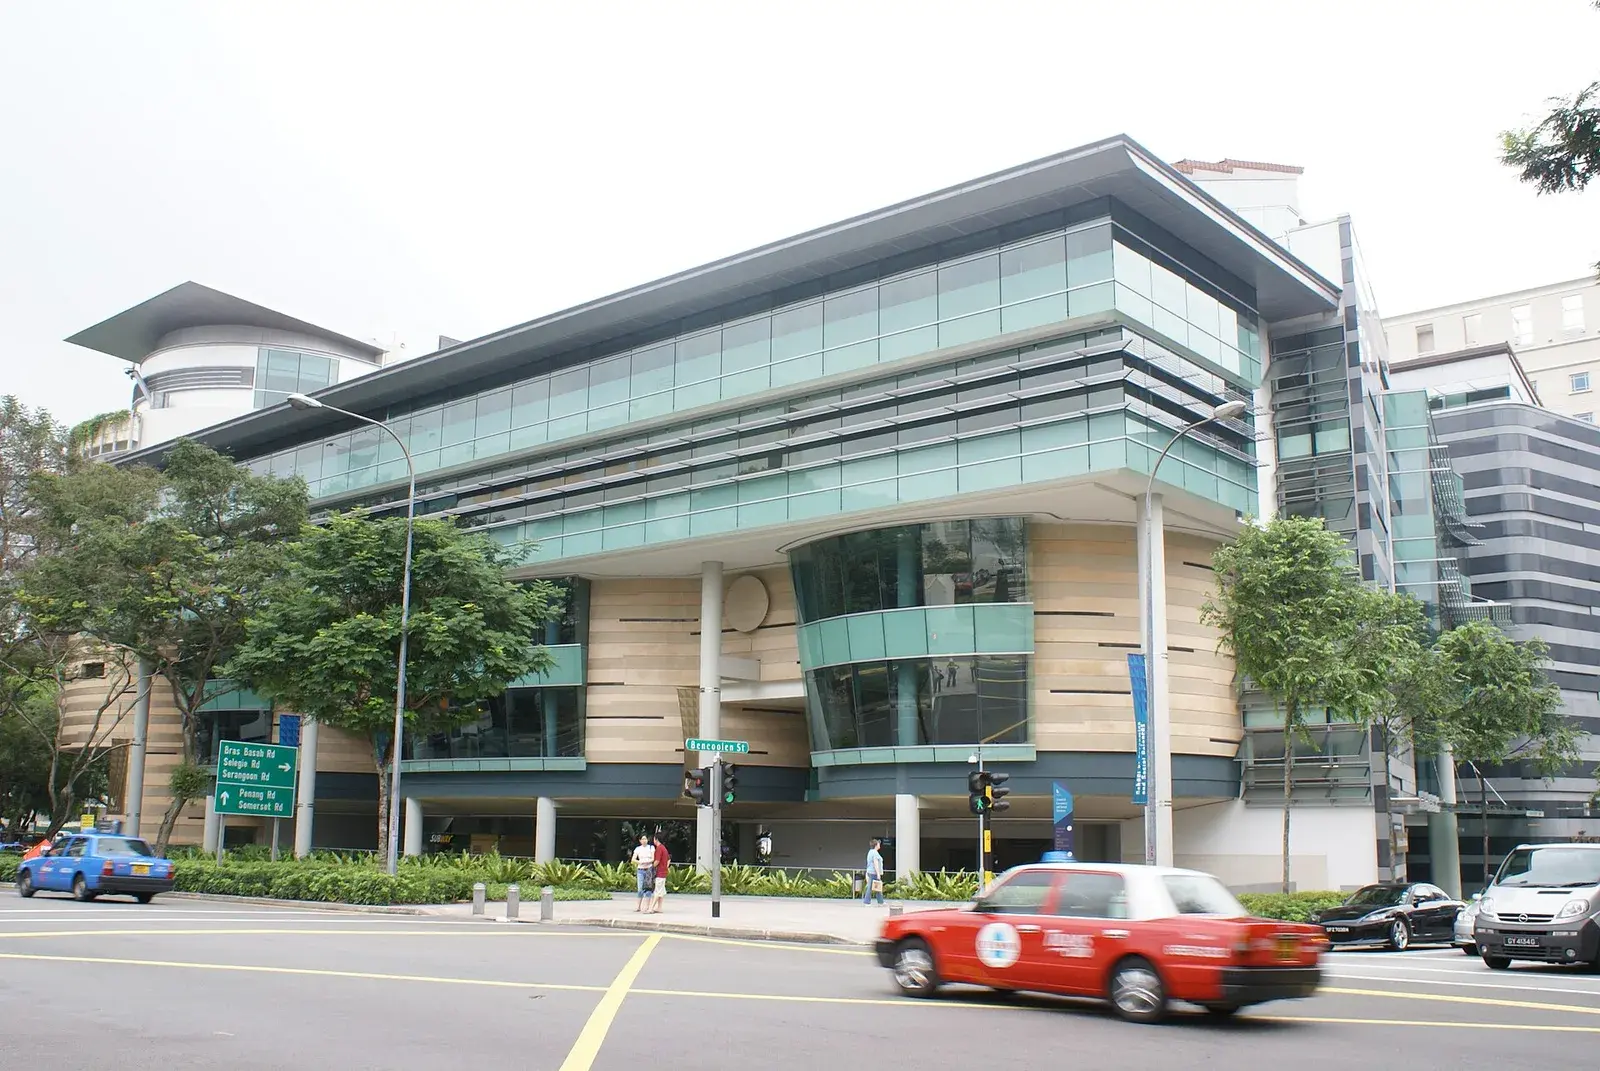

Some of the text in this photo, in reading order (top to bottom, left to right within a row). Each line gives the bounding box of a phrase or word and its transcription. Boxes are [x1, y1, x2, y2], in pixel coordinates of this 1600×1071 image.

[224, 745, 276, 759] Bras Basah Rd
[690, 740, 746, 752] Bencoolen St
[223, 757, 260, 769] Selegie Rd
[222, 769, 270, 781] Serangoon Rd
[239, 788, 276, 801] Penang Rd
[238, 801, 283, 812] Somerset Rd
